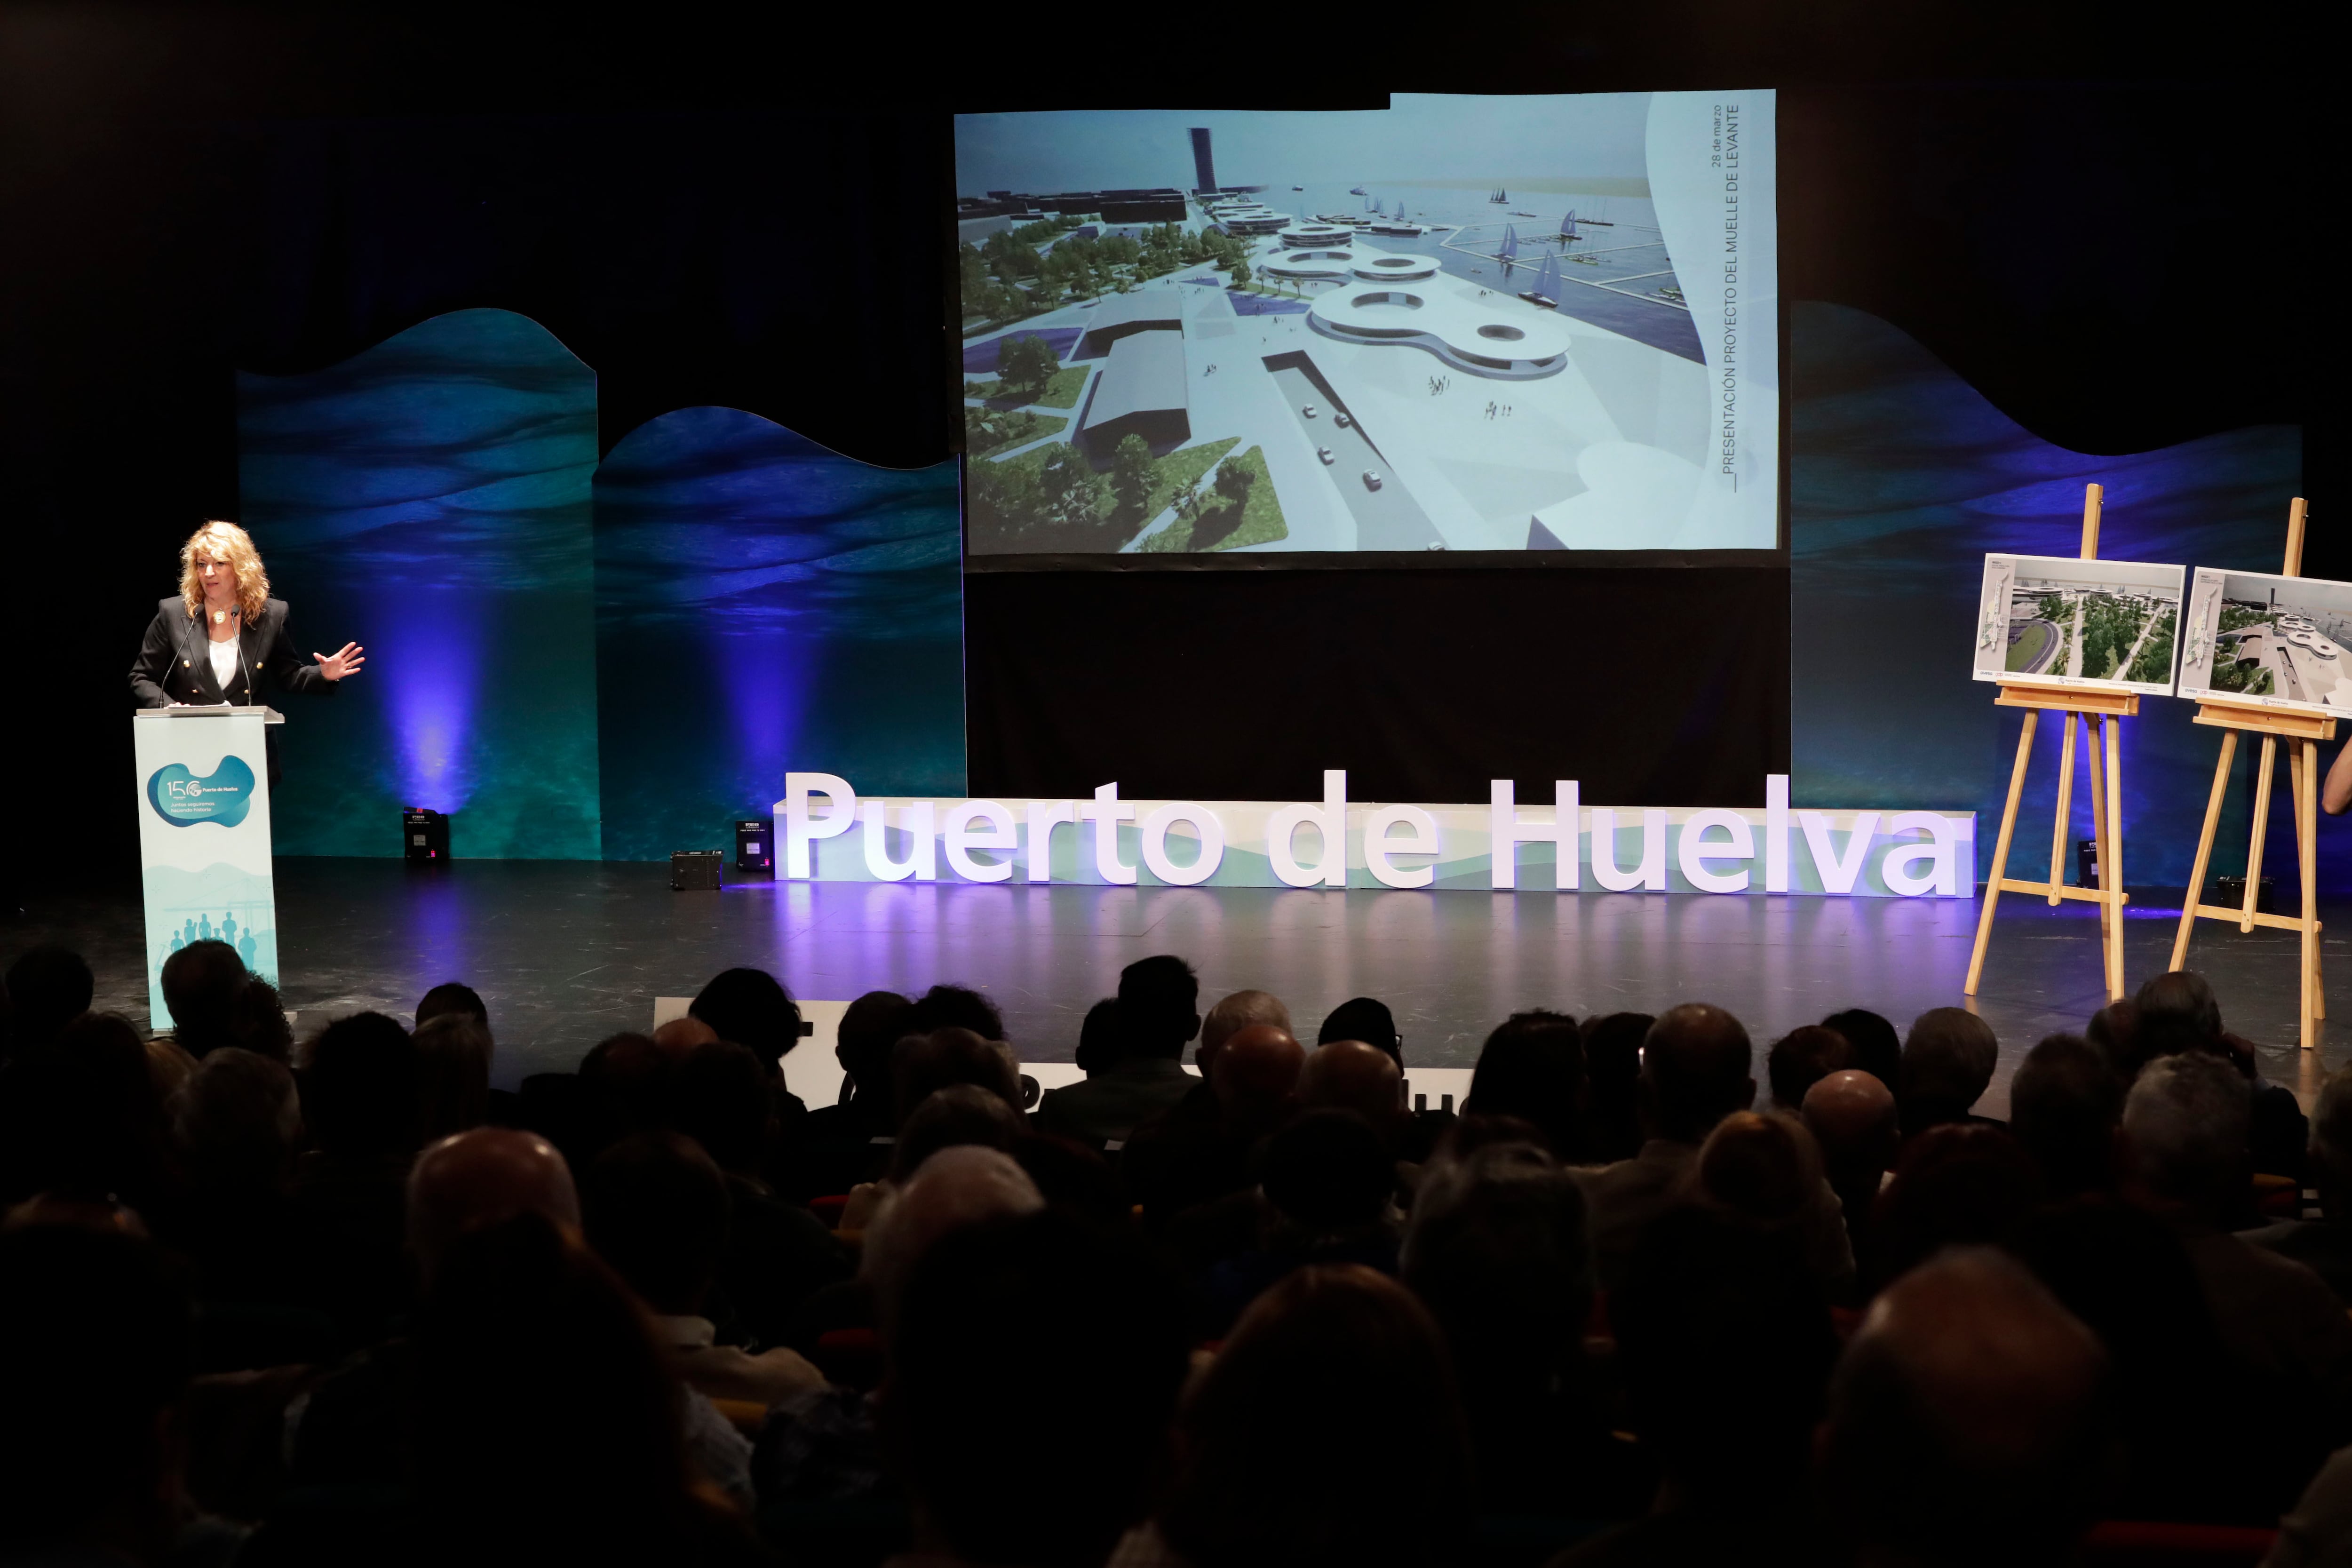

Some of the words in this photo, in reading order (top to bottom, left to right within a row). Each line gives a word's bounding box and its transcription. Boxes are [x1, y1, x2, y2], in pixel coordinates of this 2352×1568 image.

[1712, 138, 1721, 152] de
[1712, 154, 1721, 167] 28
[1726, 104, 1739, 168] LEVANTE
[1726, 173, 1738, 191] DE
[1725, 196, 1738, 253] MUELLE
[1725, 256, 1737, 284] DEL
[1724, 287, 1737, 363] PROYECTO
[1722, 367, 1736, 474] PRESENTACIÓN
[785, 772, 1225, 886] Puerto
[1267, 769, 1440, 889] de
[1490, 773, 1957, 897] Huelva
